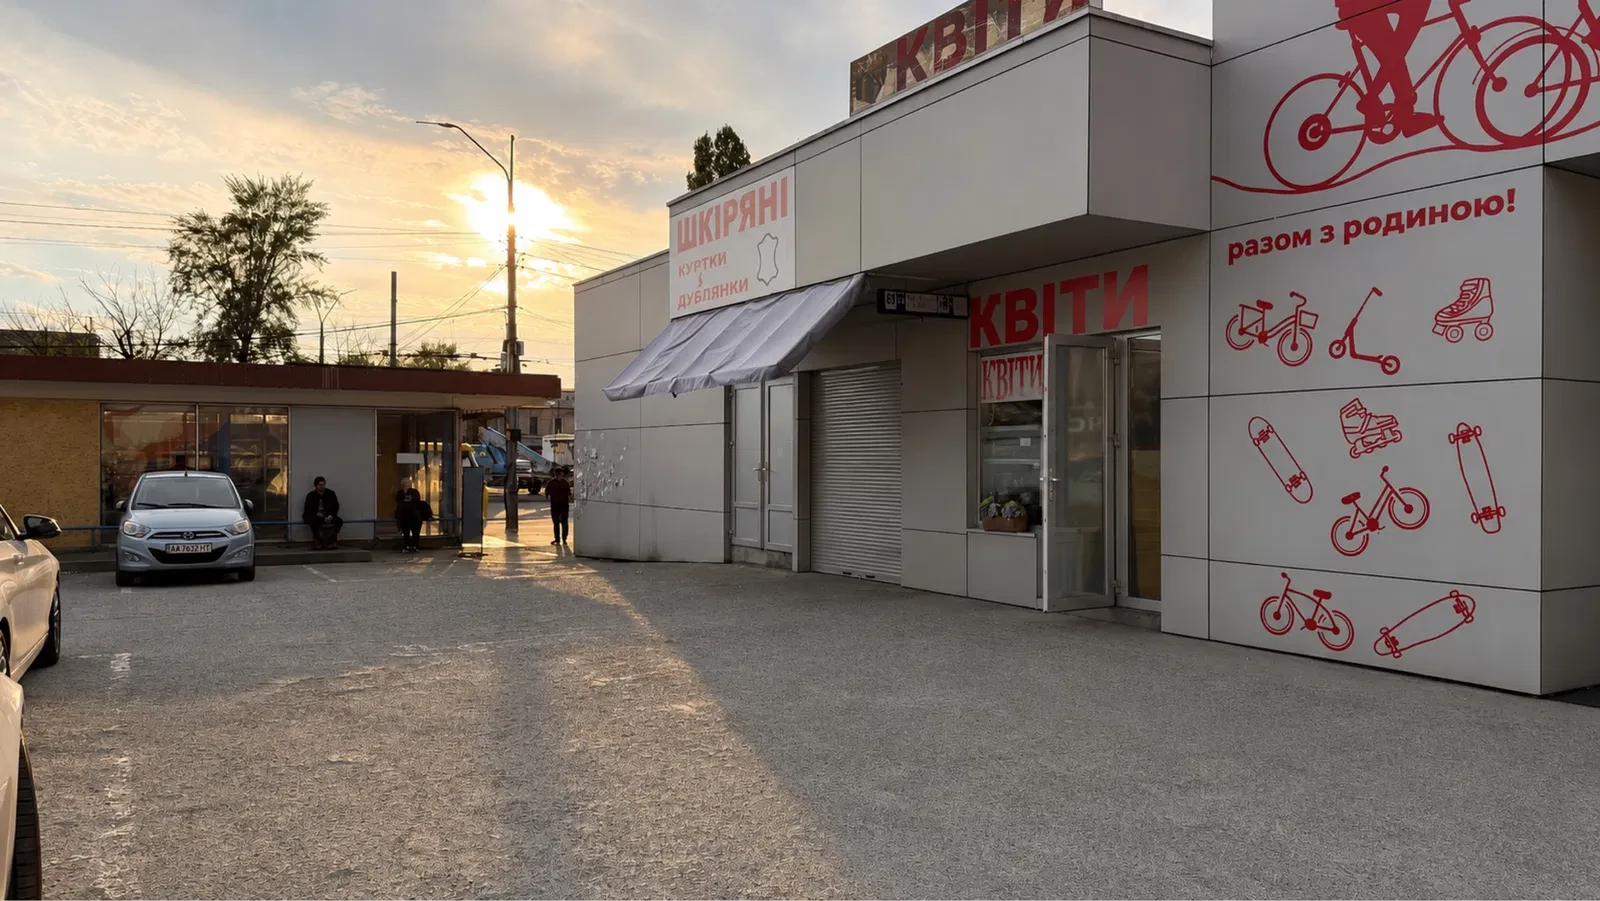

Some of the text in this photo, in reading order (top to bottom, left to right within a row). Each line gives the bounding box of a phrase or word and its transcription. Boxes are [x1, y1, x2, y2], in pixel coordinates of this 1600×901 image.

[677, 176, 788, 253] ШКІРЯНІ
[1228, 188, 1516, 265] разом з родиною!
[677, 278, 749, 311] ДУБЛЯНКИ
[678, 251, 727, 278] КУРТКИ
[969, 263, 1149, 349] КВІТИ
[981, 354, 1043, 401] КВІТИ
